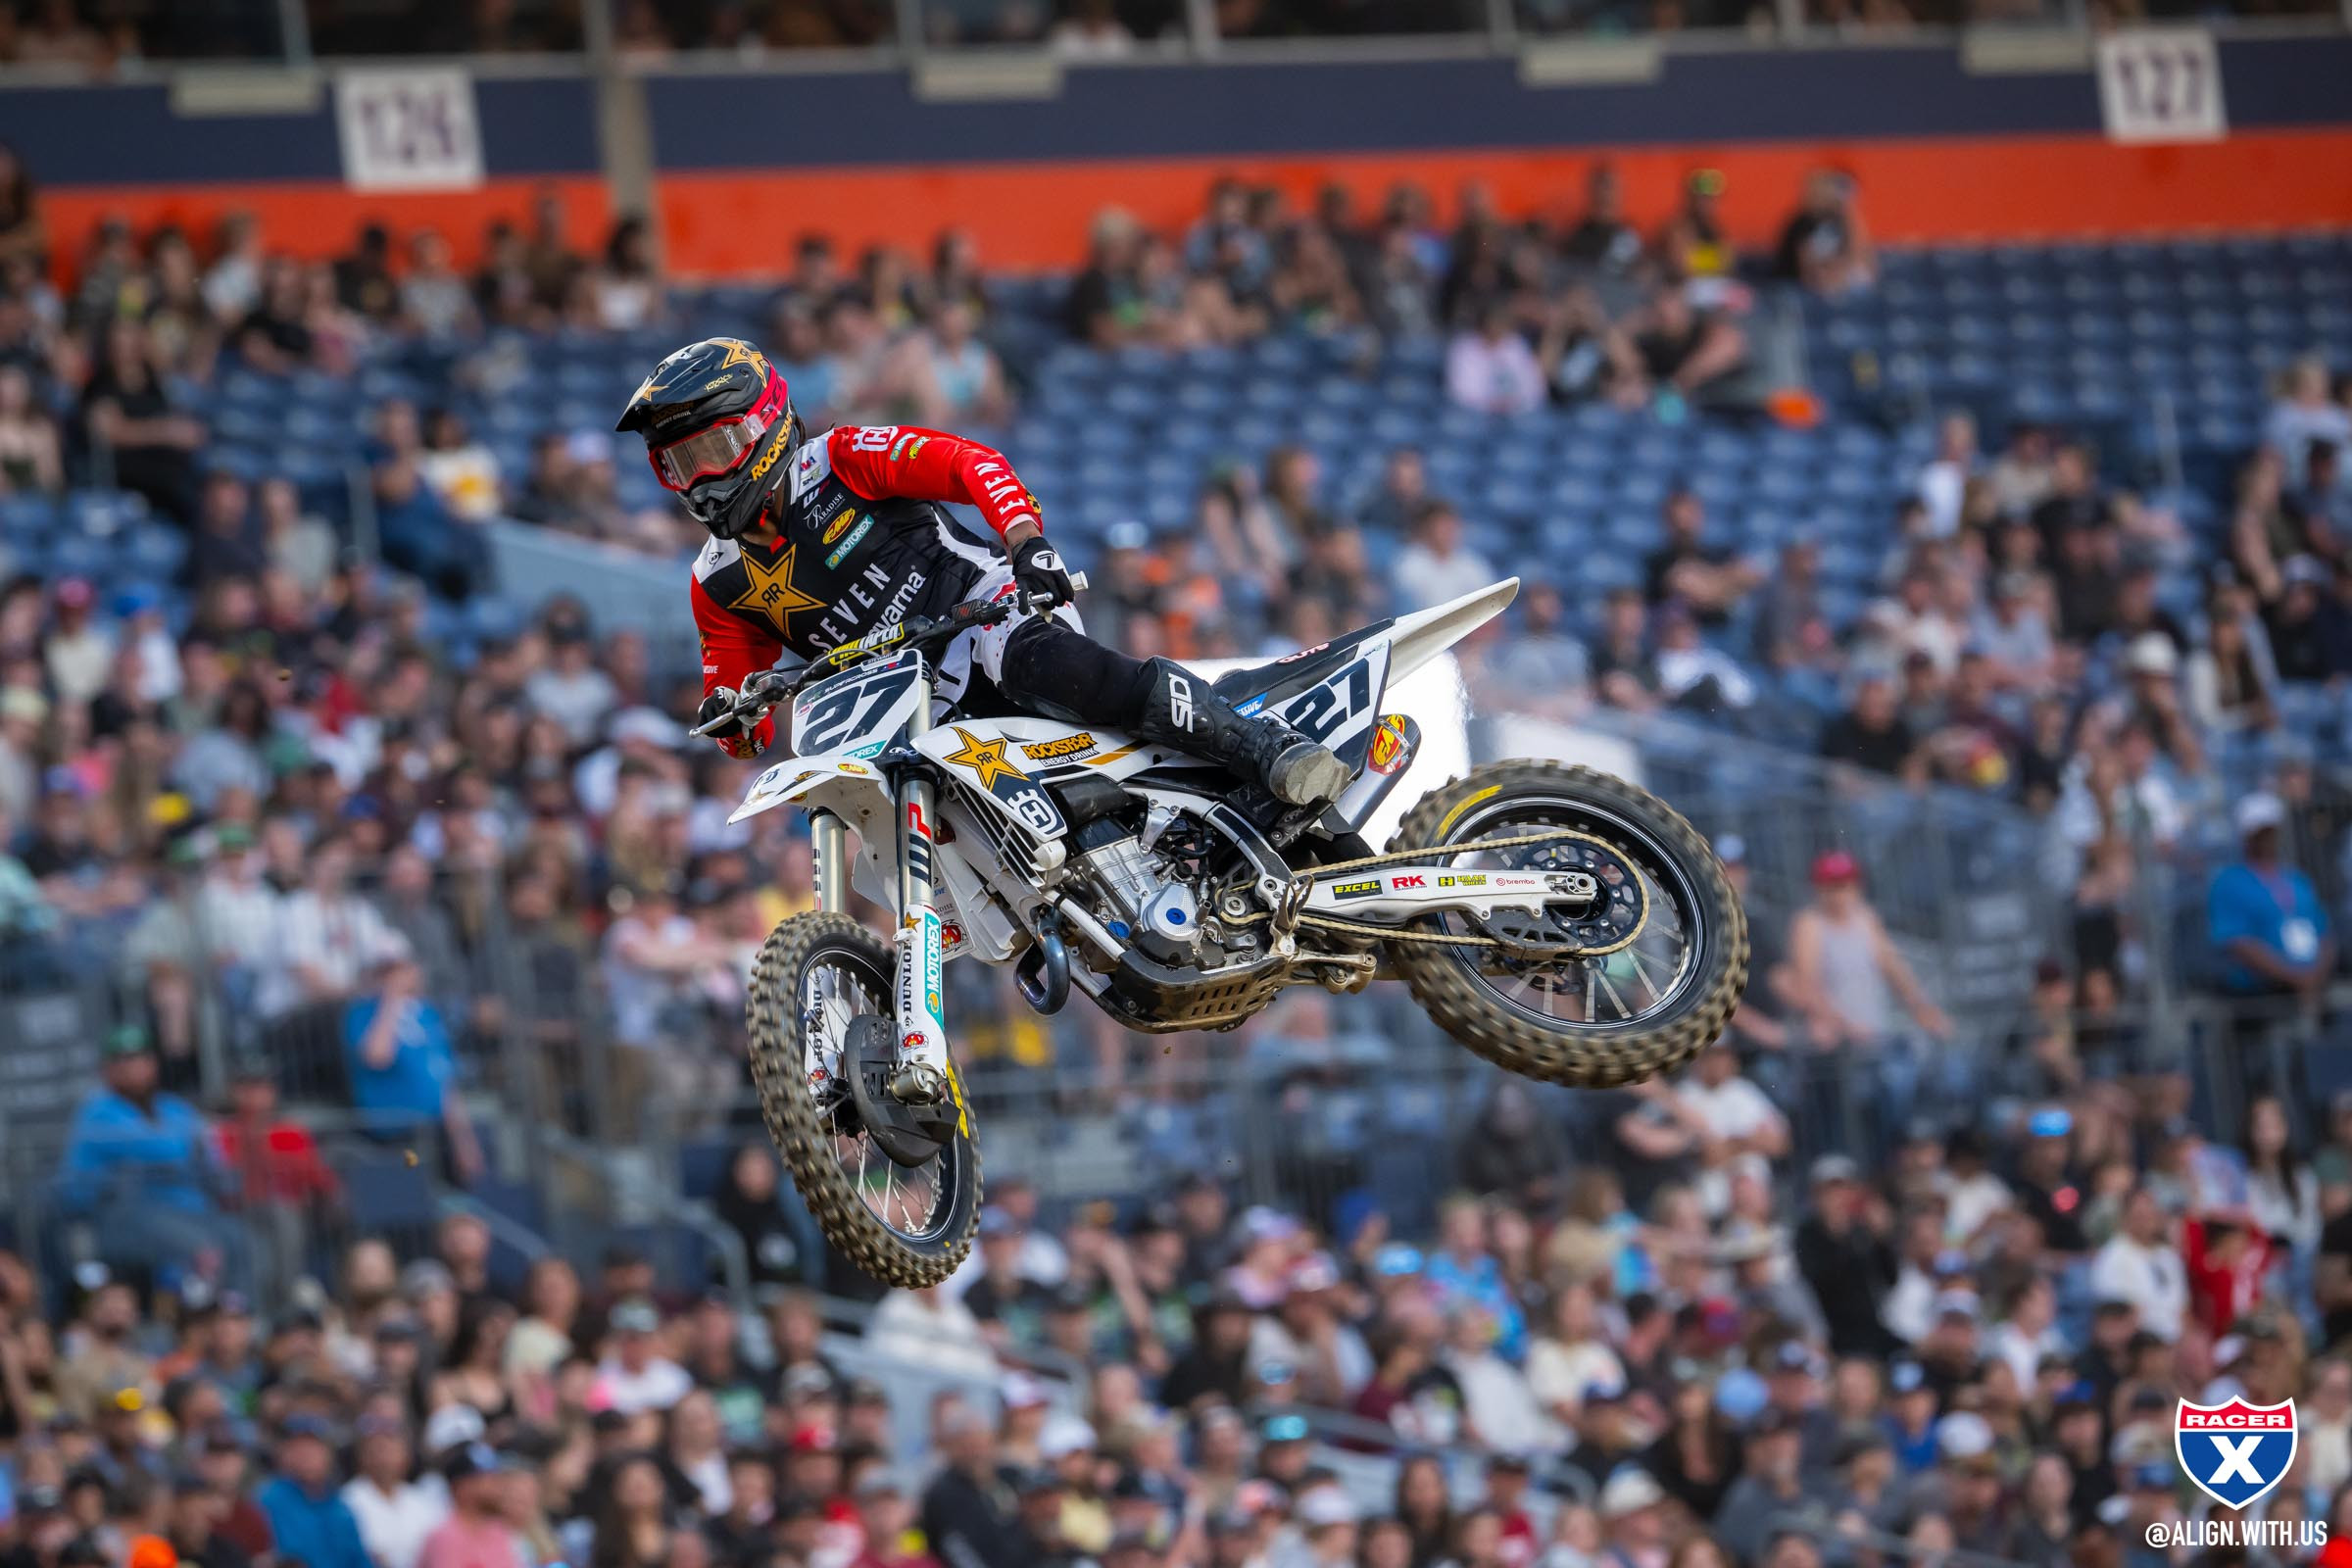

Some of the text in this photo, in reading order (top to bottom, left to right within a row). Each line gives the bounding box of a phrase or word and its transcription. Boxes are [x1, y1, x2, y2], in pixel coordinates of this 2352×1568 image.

[823, 508, 855, 544] FMF
[836, 517, 872, 558] MOTOREX
[808, 563, 891, 654] SEVEN
[798, 668, 918, 758] 27
[1285, 657, 1370, 745] 27
[1021, 733, 1097, 760] ROCKSTAR
[1041, 747, 1099, 767] ENERGY DRINK
[1335, 881, 1380, 894] EXCEL
[1392, 875, 1426, 889] RK
[926, 919, 940, 993] MOTOREX
